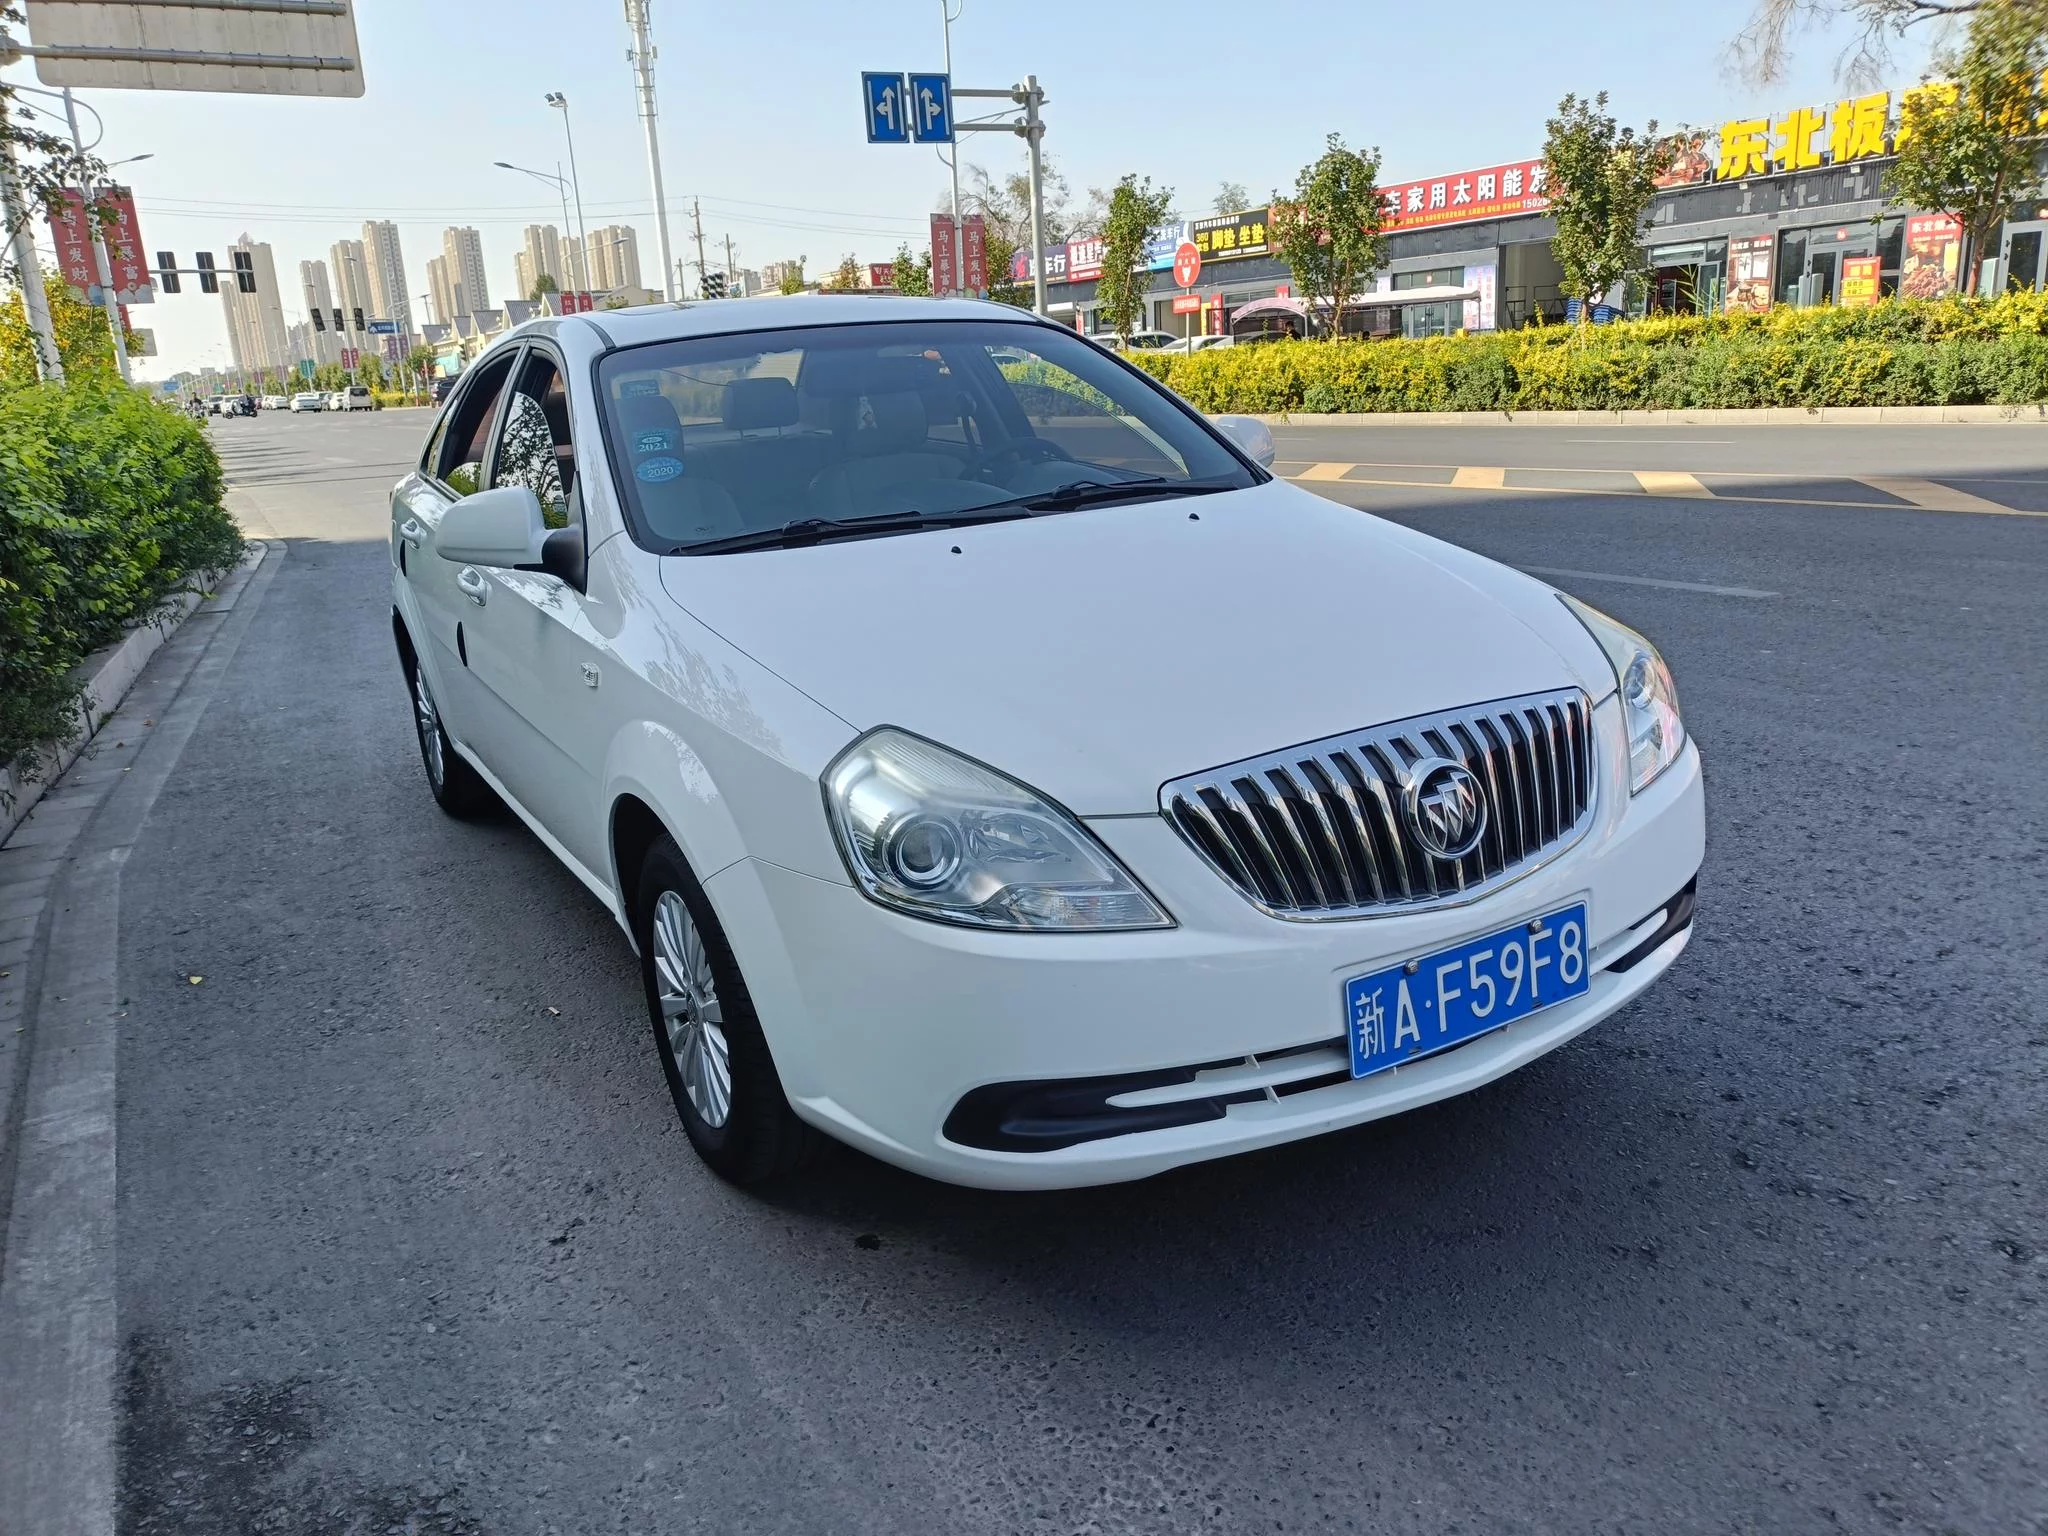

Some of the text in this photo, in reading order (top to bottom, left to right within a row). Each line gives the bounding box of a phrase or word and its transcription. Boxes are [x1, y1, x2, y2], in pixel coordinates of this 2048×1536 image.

[1378, 165, 1548, 216] 车家用太阳能发
[1522, 197, 1551, 209] 15026
[60, 210, 88, 282] 马上发财
[639, 442, 668, 452] 2021
[647, 466, 674, 478] 2020
[1355, 921, 1583, 1060] 新A·F59F8
